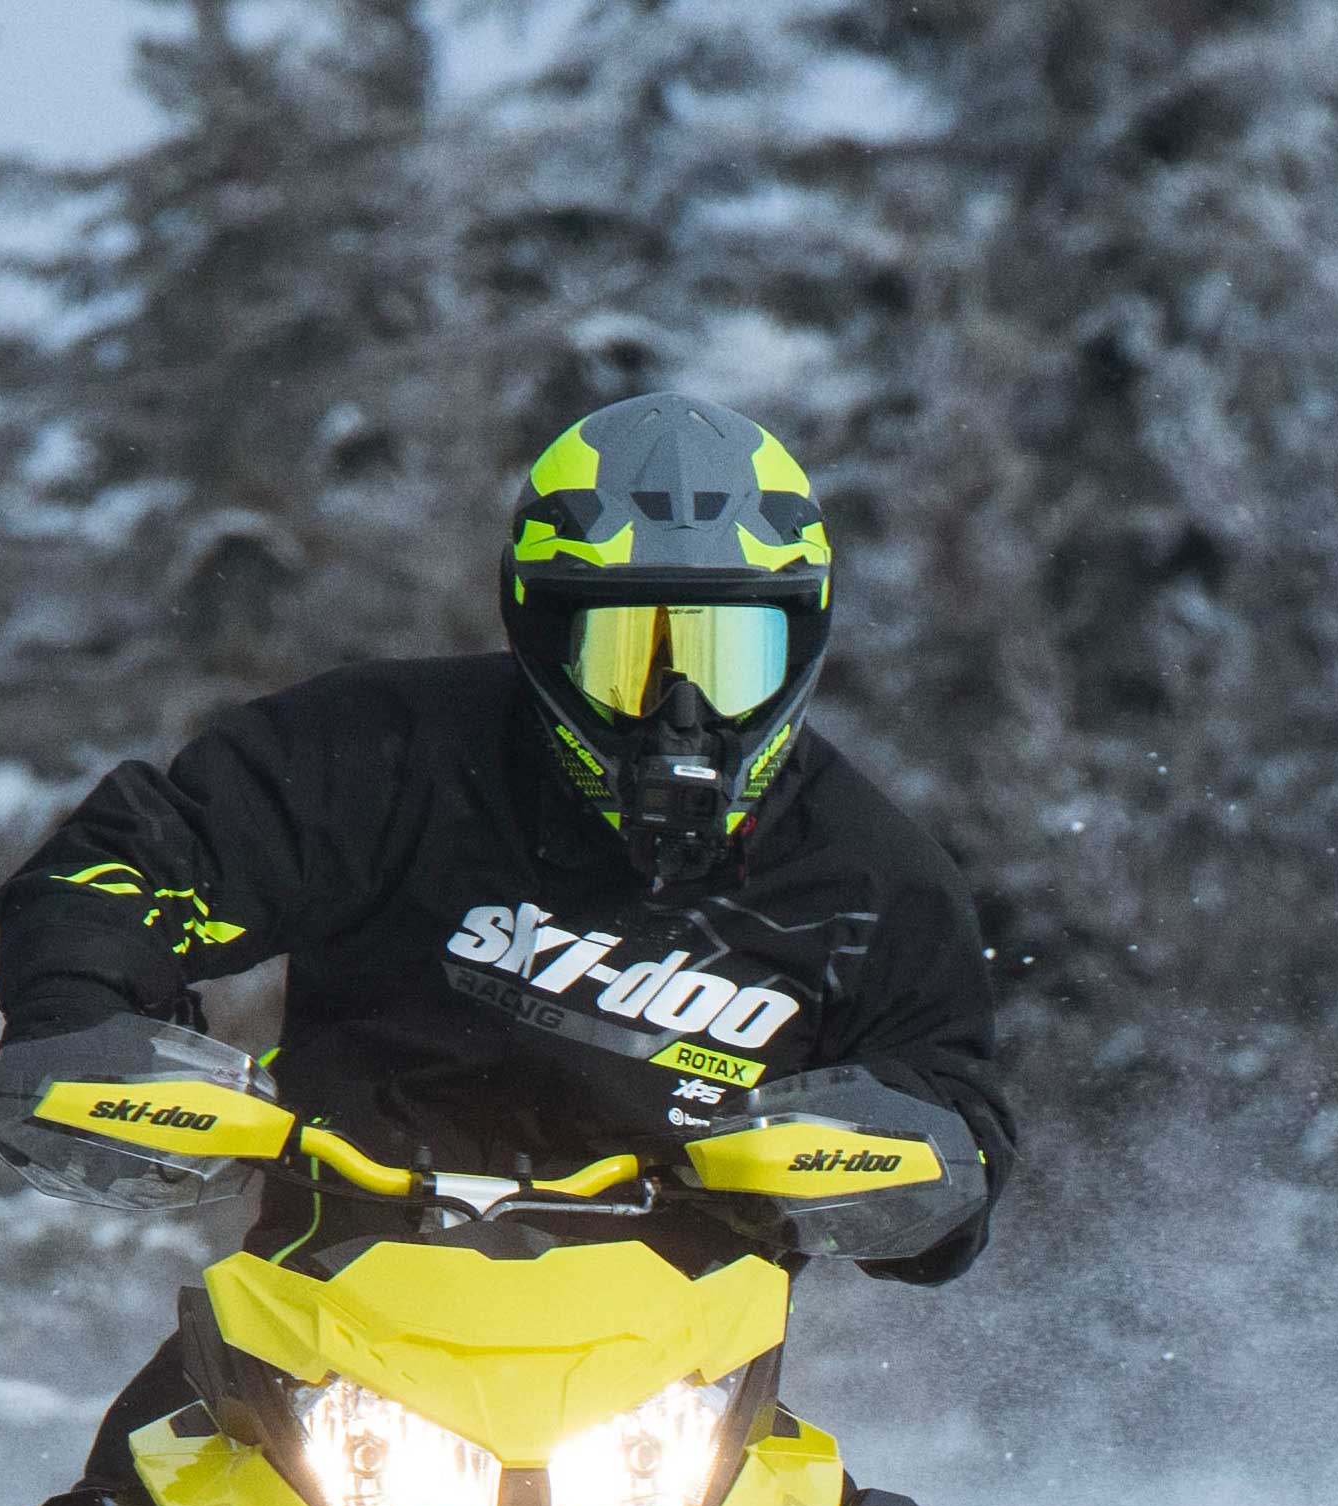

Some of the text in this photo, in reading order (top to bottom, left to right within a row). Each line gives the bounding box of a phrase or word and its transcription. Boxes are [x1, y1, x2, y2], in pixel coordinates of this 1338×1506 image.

[446, 902, 800, 1048] ski-doo
[676, 1047, 746, 1082] ROTAX
[671, 1078, 727, 1105] XPS
[89, 1099, 218, 1131] ski-doo
[788, 1149, 902, 1172] ski-doo
